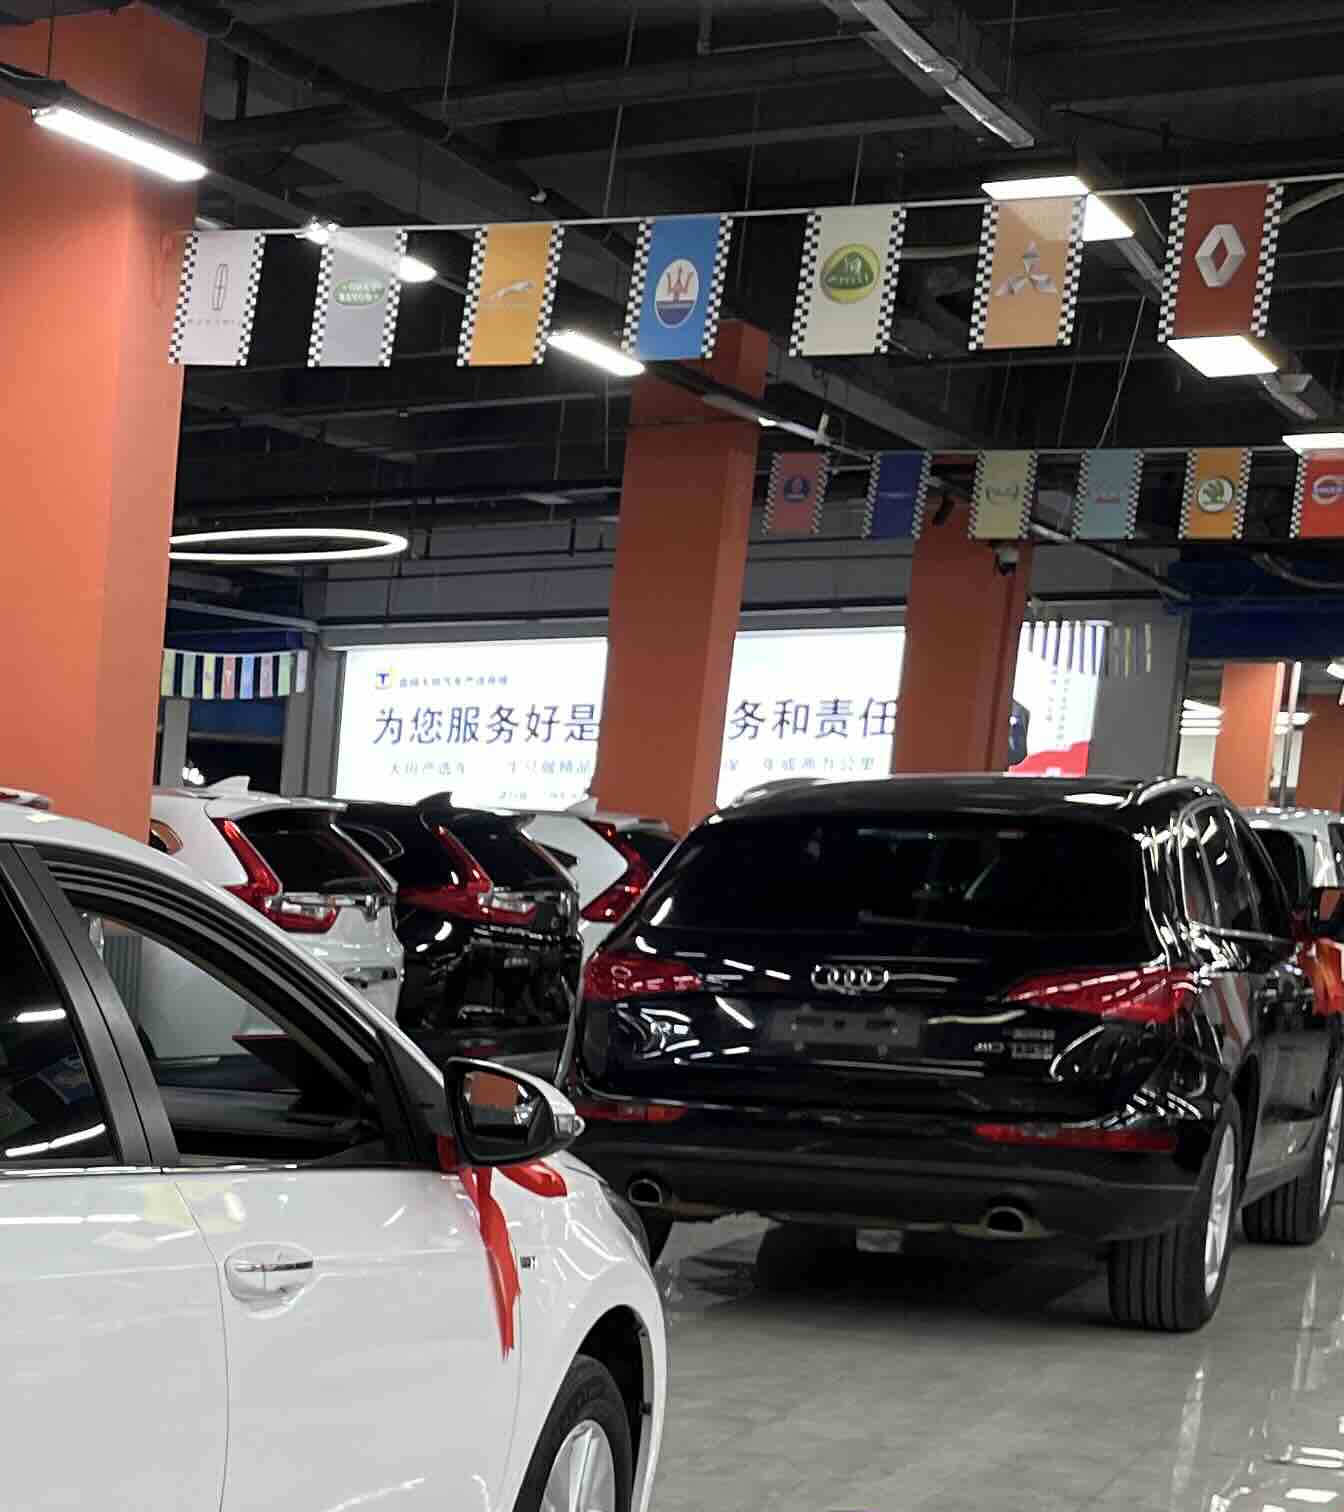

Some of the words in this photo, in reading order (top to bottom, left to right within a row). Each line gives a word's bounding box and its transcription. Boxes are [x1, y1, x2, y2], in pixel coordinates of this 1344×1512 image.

[373, 703, 600, 744] 为您服务好是
[728, 697, 897, 740] 务和责任
